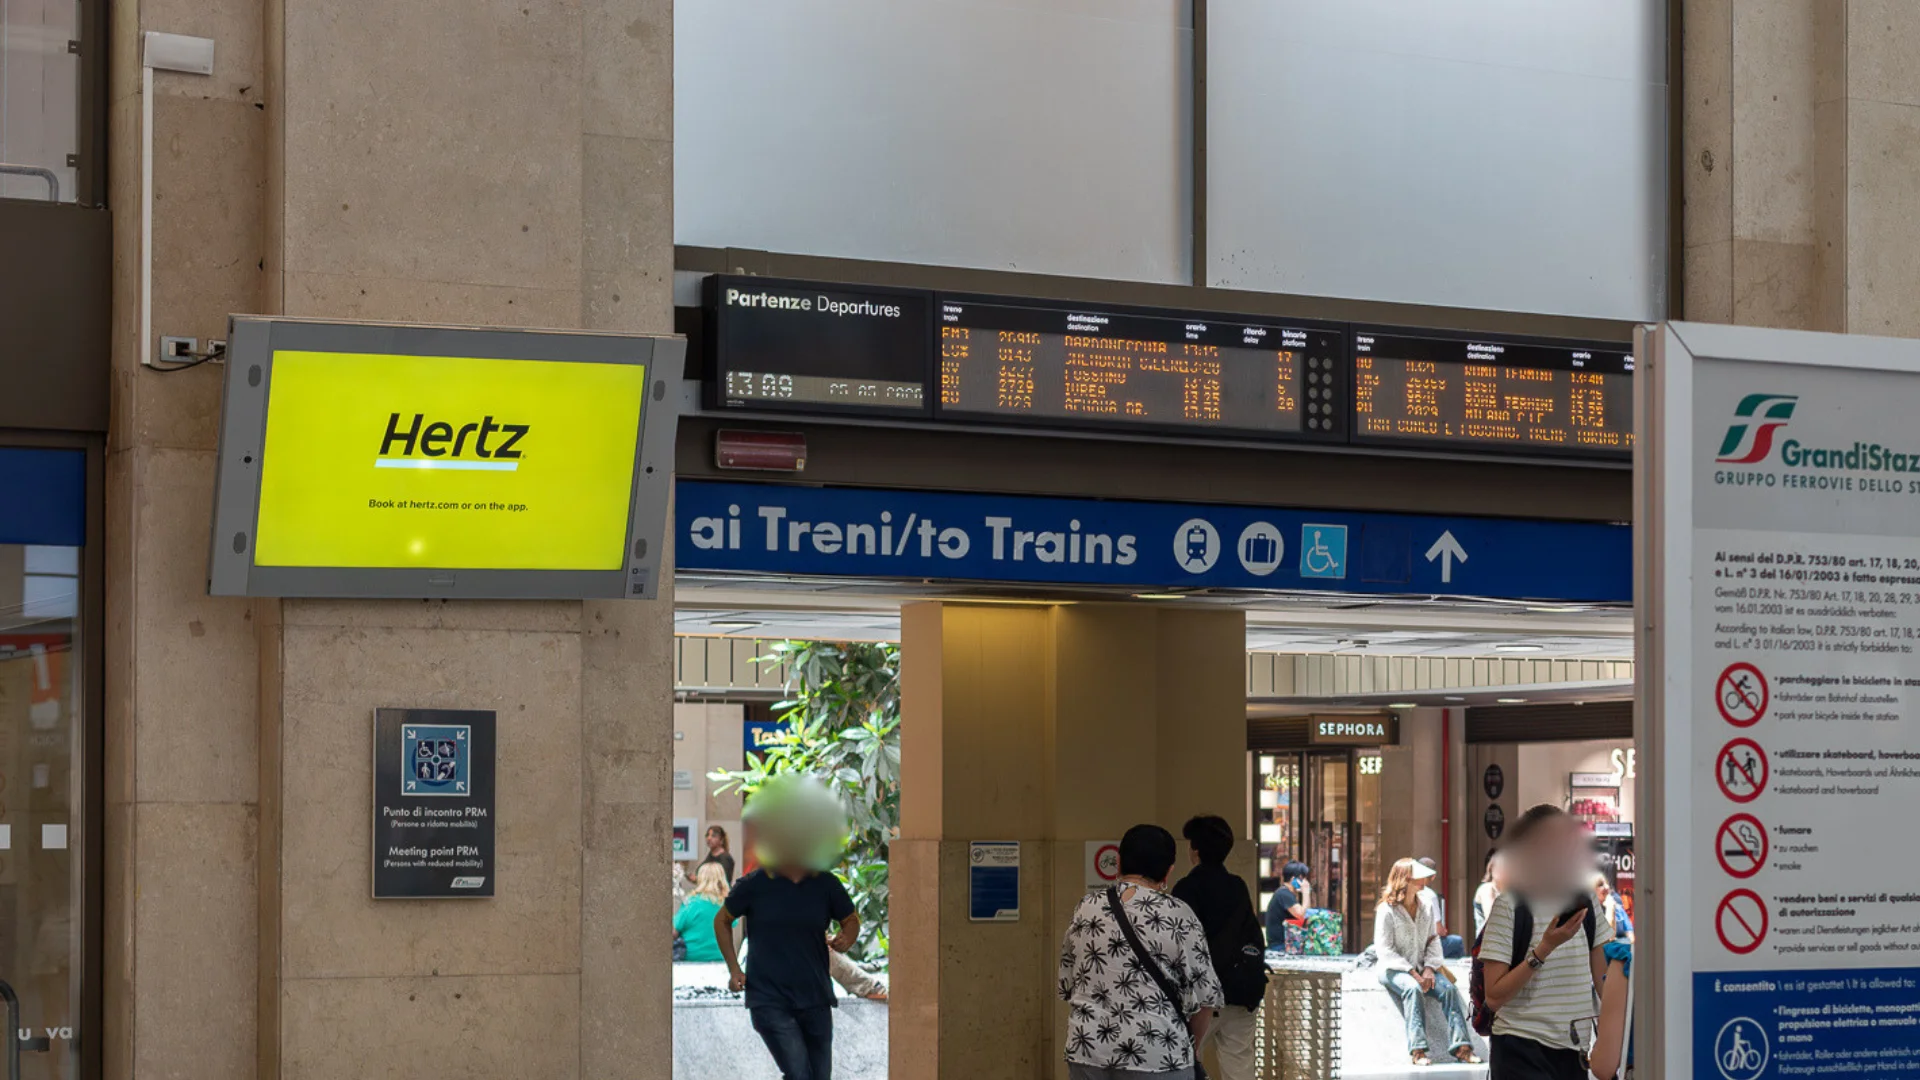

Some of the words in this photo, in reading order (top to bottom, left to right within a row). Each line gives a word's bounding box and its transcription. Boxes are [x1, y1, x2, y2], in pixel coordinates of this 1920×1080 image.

[726, 289, 812, 311] Partenze
[818, 296, 900, 318] Departures
[943, 314, 958, 322] train
[1067, 314, 1109, 324] destinazione
[1067, 323, 1099, 332] destination
[1186, 324, 1206, 332] orario
[1243, 328, 1266, 336] ritardo
[1282, 331, 1307, 339] binario
[379, 413, 530, 458] Hertz
[1781, 439, 1920, 472] GrandiStaz
[1715, 471, 1776, 486] GRUPPO
[1783, 475, 1853, 490] FERROVIE
[1860, 479, 1902, 493] DELLO
[369, 499, 394, 508] Book
[410, 501, 458, 510] hertz.com
[462, 502, 472, 510] or
[489, 502, 505, 510] the
[508, 503, 528, 512] app.
[690, 504, 740, 550] ai
[758, 506, 970, 559] Treni/to
[986, 516, 1137, 566] Trains
[1715, 552, 1725, 562] Ai
[1729, 552, 1754, 563] sensi
[1757, 553, 1774, 564] del
[1777, 554, 1804, 565] D.P.R.
[1809, 555, 1845, 566] 753/80
[1848, 558, 1866, 568] art.
[1870, 557, 1882, 569] 17,
[1887, 558, 1900, 570] 18,
[1725, 568, 1734, 578] L.
[1750, 569, 1756, 579] 3
[1760, 568, 1775, 579] del
[1779, 570, 1840, 581] 16/01/2003
[1853, 574, 1876, 583] fatto
[1715, 588, 1747, 598] Gemäß
[1774, 590, 1786, 600] Nr.
[1789, 590, 1821, 600] 753/80
[1824, 592, 1840, 601] Art.
[1736, 603, 1783, 614] 16.01.2003
[1785, 605, 1794, 614] ist
[1807, 605, 1855, 616] ausdrücklich
[1858, 608, 1896, 618] verboten:
[1715, 623, 1756, 636] According
[1759, 625, 1768, 634] to
[1798, 626, 1814, 636] law,
[1840, 626, 1871, 636] 753/80
[1873, 628, 1888, 637] art.
[1715, 639, 1732, 648] and
[1754, 640, 1761, 649] 3
[1763, 640, 1815, 651] 01/16/2003
[1834, 641, 1858, 653] strictly
[1860, 641, 1899, 653] forbidden
[1779, 676, 1840, 685] parcheggiare
[1842, 676, 1850, 685] le
[1853, 676, 1891, 686] biciclette
[1894, 676, 1902, 686] in
[1779, 694, 1813, 702] fahrräder
[1828, 693, 1858, 702] Bahnhof
[1860, 694, 1898, 703] abzustellen
[1779, 712, 1795, 721] park
[1798, 714, 1813, 722] your
[1815, 712, 1838, 721] bicycle
[1841, 712, 1860, 720] inside
[1863, 712, 1873, 720] the
[1876, 712, 1899, 721] station
[1319, 723, 1384, 735] SEPHORA
[1779, 749, 1820, 759] utilizzare
[1823, 750, 1875, 760] skateboard,
[1779, 767, 1824, 777] skateboards,
[1826, 768, 1872, 777] Hoverboards
[1875, 769, 1887, 777] und
[1779, 785, 1819, 795] skateboard
[1821, 786, 1835, 794] and
[1837, 786, 1878, 795] hoverboard
[384, 806, 409, 817] Punto
[412, 807, 422, 817] di
[425, 808, 463, 817] incontro
[465, 807, 487, 817] PRM
[391, 820, 419, 828] (Persone
[427, 820, 448, 828] ridotta
[450, 820, 477, 828] mobilità)
[1779, 826, 1812, 835] fumare
[389, 846, 428, 858] Meeting
[431, 847, 454, 858] point
[457, 847, 478, 856] PRM
[1789, 844, 1818, 852] rauchen
[384, 859, 410, 868] (Persons
[428, 859, 453, 867] reduced
[456, 860, 483, 868] mobility)
[1779, 862, 1801, 870] smoke
[1779, 895, 1815, 903] vendere
[1818, 894, 1837, 903] beni
[1848, 893, 1876, 902] servizi
[1879, 893, 1887, 902] di
[1779, 908, 1788, 917] di
[1790, 907, 1855, 917] autorizzazione
[1779, 927, 1800, 935] waren
[1802, 926, 1815, 935] und
[1817, 925, 1870, 936] Dienstleistungen
[1872, 924, 1898, 935] jeglicher
[1900, 924, 1910, 933] Art
[1779, 944, 1805, 954] provide
[1808, 944, 1835, 952] services
[1847, 942, 1857, 951] sell
[1860, 942, 1881, 953] goods
[1884, 941, 1909, 951] without
[1724, 980, 1775, 992] consentito
[1796, 981, 1805, 990] ist
[1808, 980, 1844, 992] gestattet
[1869, 977, 1901, 989] allowed
[1779, 1005, 1819, 1017] l'ingresso
[1822, 1004, 1830, 1013] di
[1833, 1004, 1873, 1014] biciclette,
[1779, 1018, 1831, 1031] propulsione
[1834, 1017, 1868, 1027] elettrica
[1879, 1016, 1916, 1026] manuale
[1787, 1034, 1813, 1042] mano
[1835, 1049, 1851, 1058] oder
[1853, 1048, 1877, 1058] andere
[1779, 1064, 1815, 1075] Fahrzeuge
